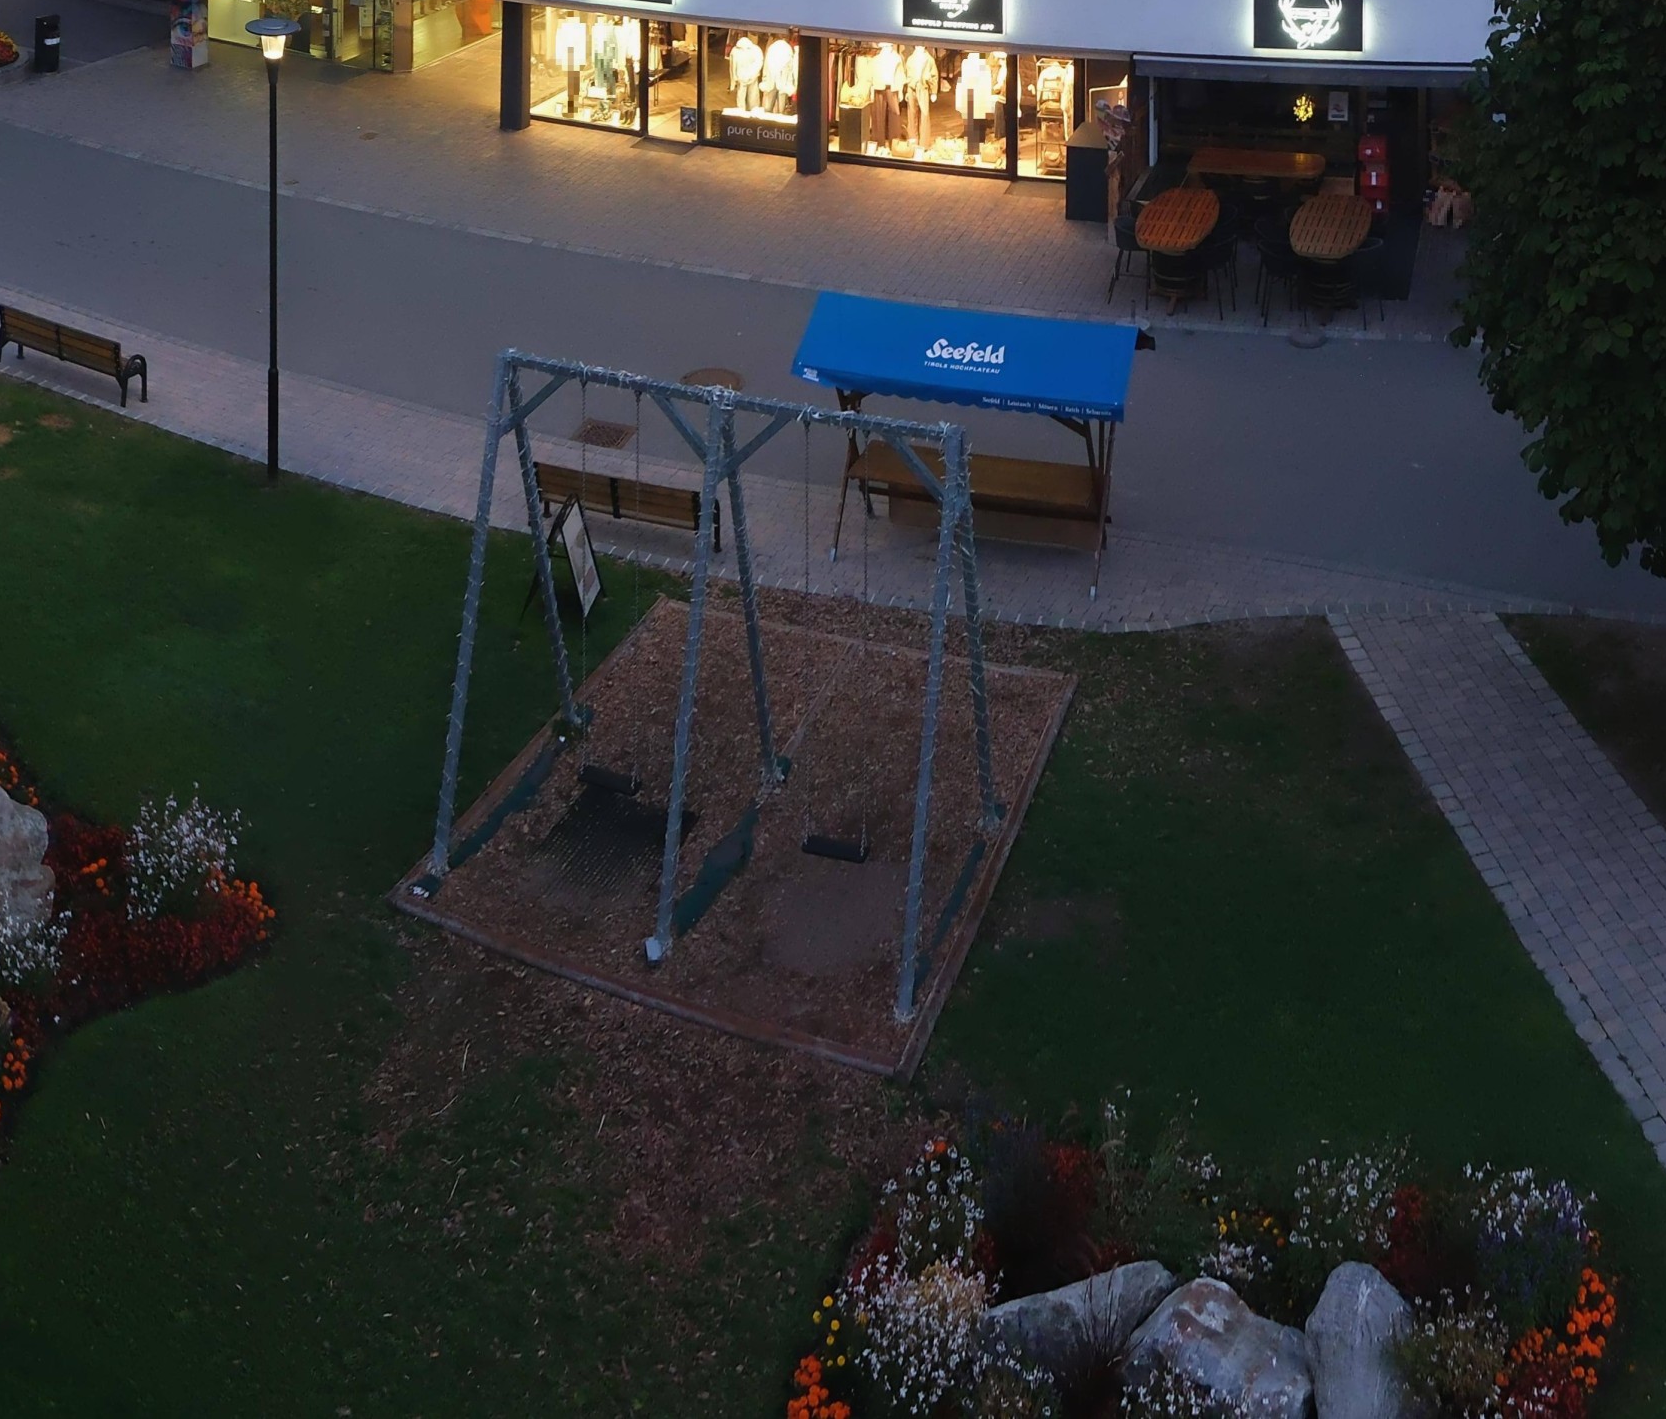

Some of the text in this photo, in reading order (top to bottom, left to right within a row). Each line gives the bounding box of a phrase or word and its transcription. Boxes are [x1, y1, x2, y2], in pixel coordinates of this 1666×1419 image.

[727, 126, 753, 137] pure
[925, 338, 1005, 364] Seefeld
[924, 360, 1000, 374] TIROLS HOCHPLATEAU
